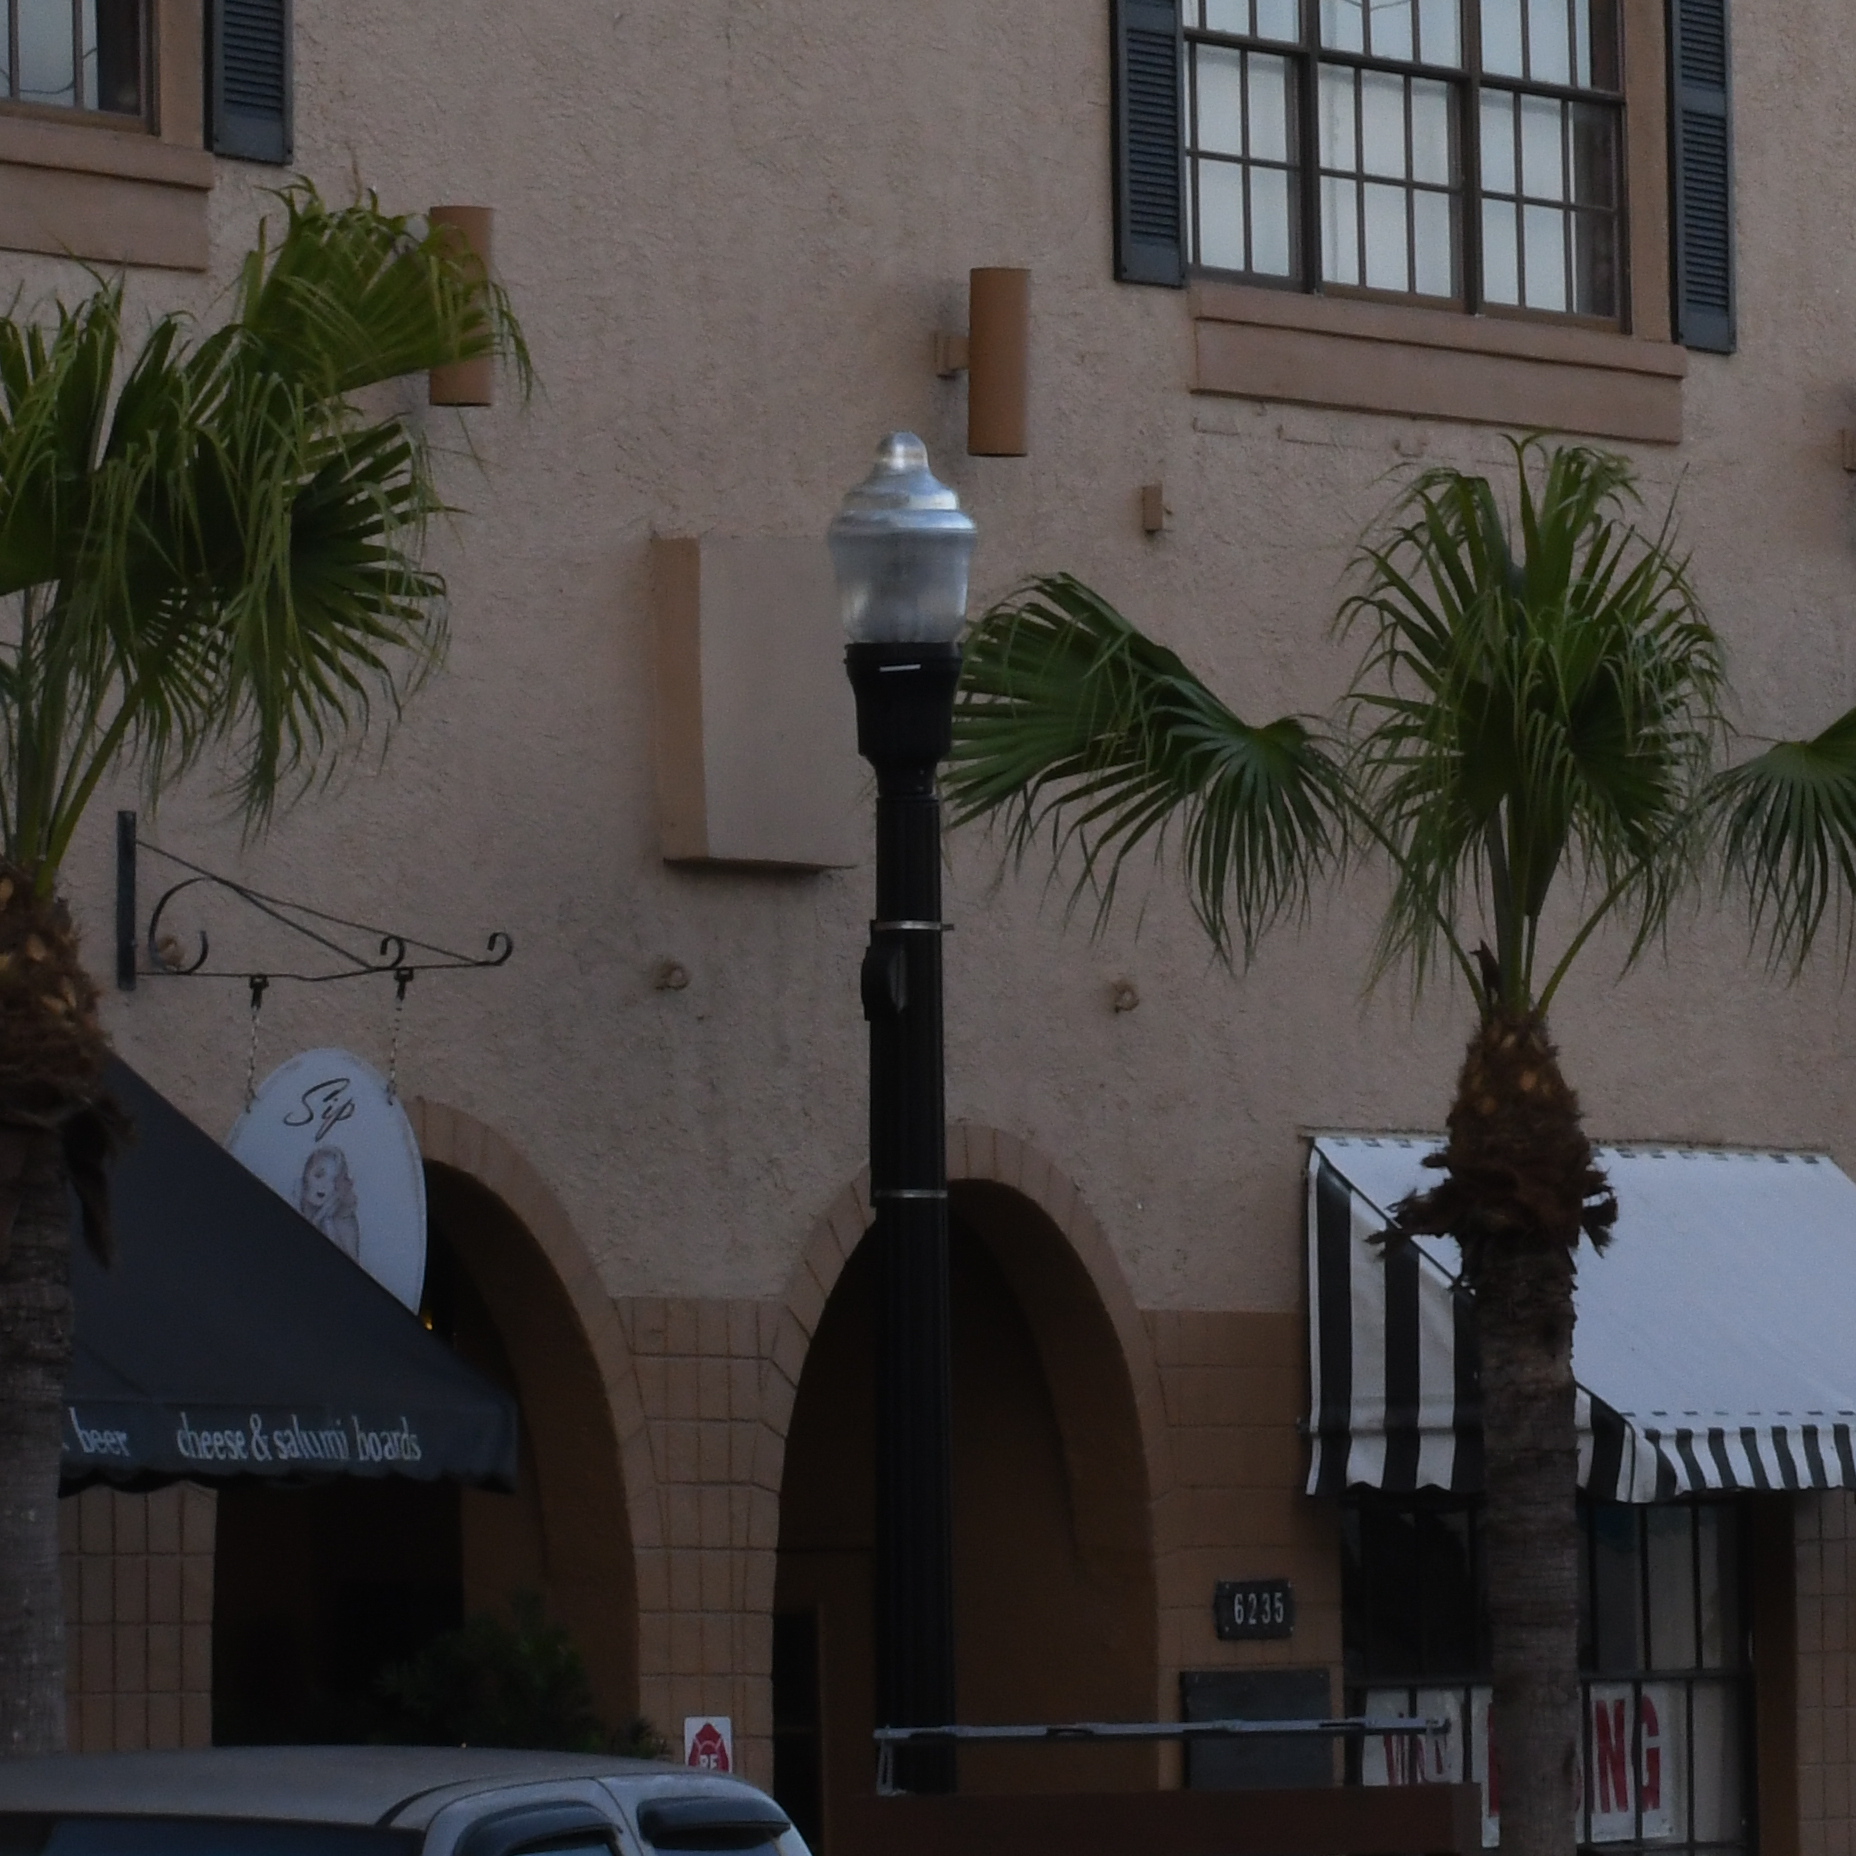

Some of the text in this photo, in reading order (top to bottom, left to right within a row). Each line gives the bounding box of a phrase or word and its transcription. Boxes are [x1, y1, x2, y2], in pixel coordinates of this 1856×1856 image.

[284, 1078, 355, 1142] Sip
[69, 1406, 421, 1462] beer cheese & salumi boards
[1234, 1592, 1284, 1625] 6235
